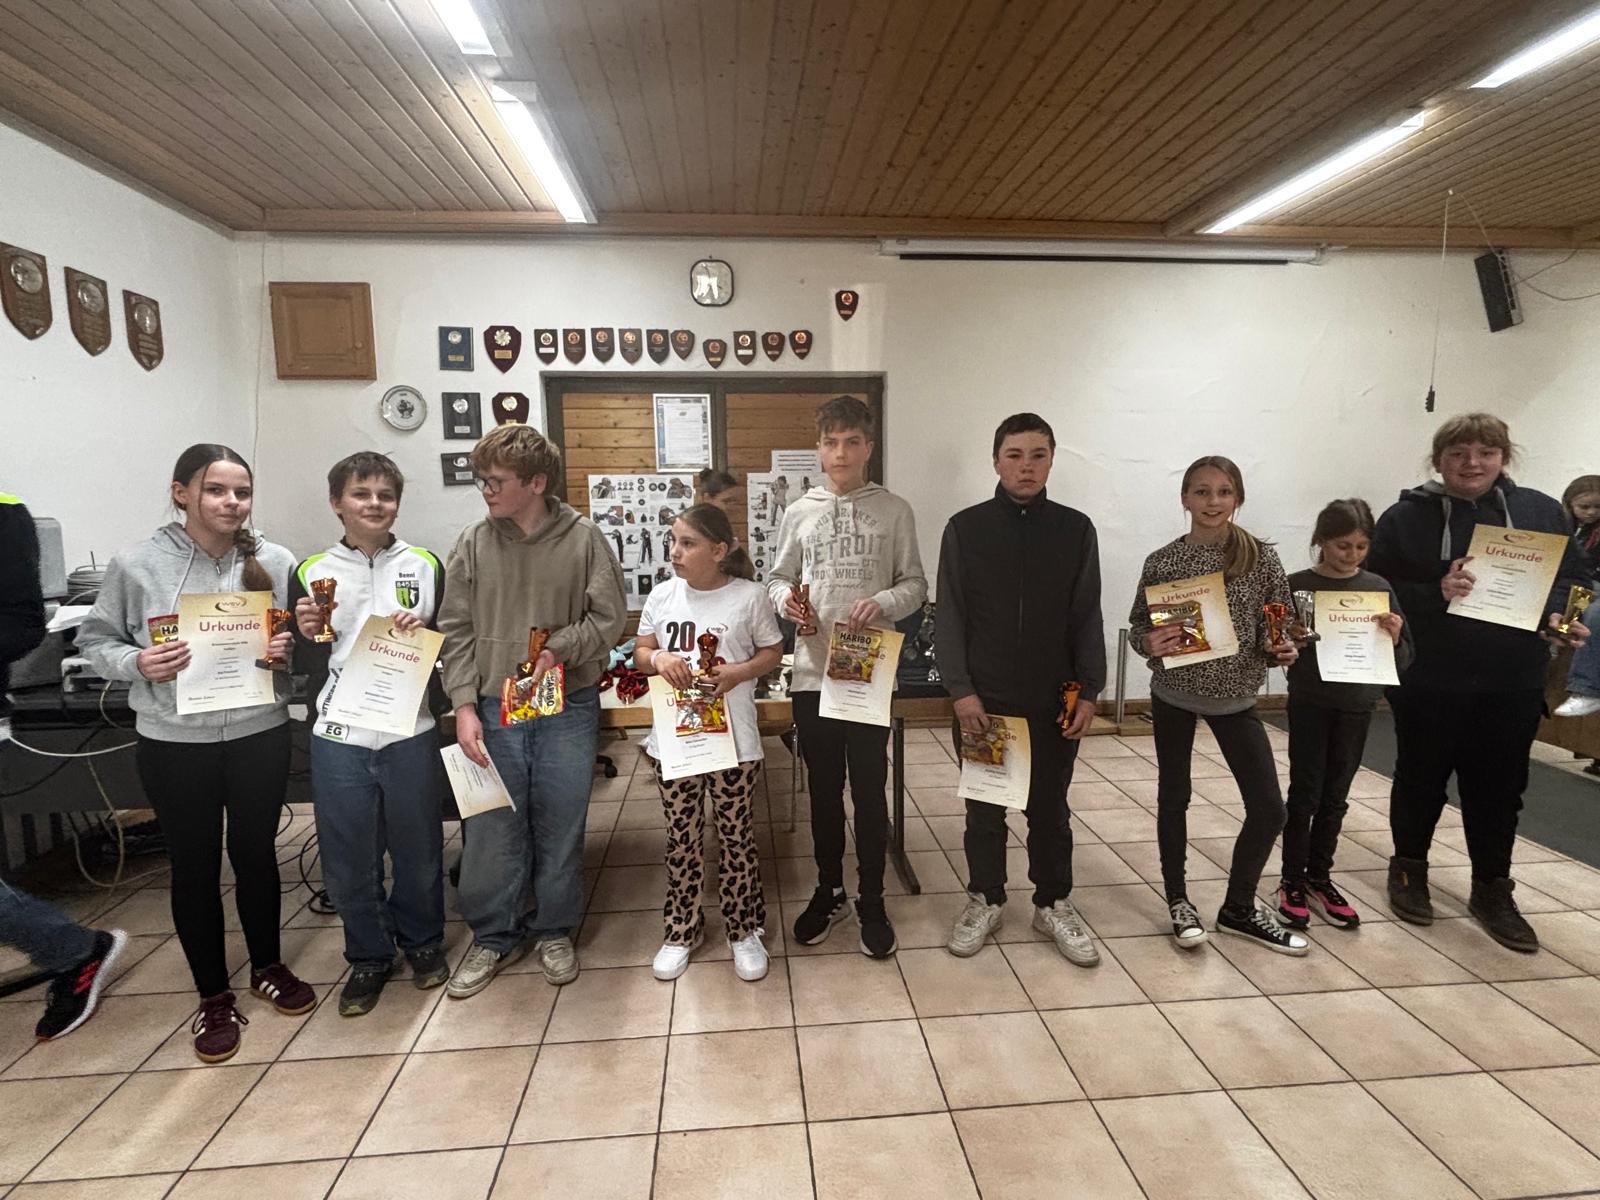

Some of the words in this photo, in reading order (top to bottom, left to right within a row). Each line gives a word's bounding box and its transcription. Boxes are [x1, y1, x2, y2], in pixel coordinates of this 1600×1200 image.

[803, 533, 887, 568] DETROIT
[1485, 546, 1543, 563] Urkunde
[1161, 587, 1210, 603] Urkunde
[199, 620, 261, 632] Urkunde
[1328, 614, 1377, 623] Urkunde
[666, 621, 696, 652] 20
[840, 632, 872, 645] HARIBO
[368, 640, 422, 663] Urkunde
[325, 724, 342, 736] EG
